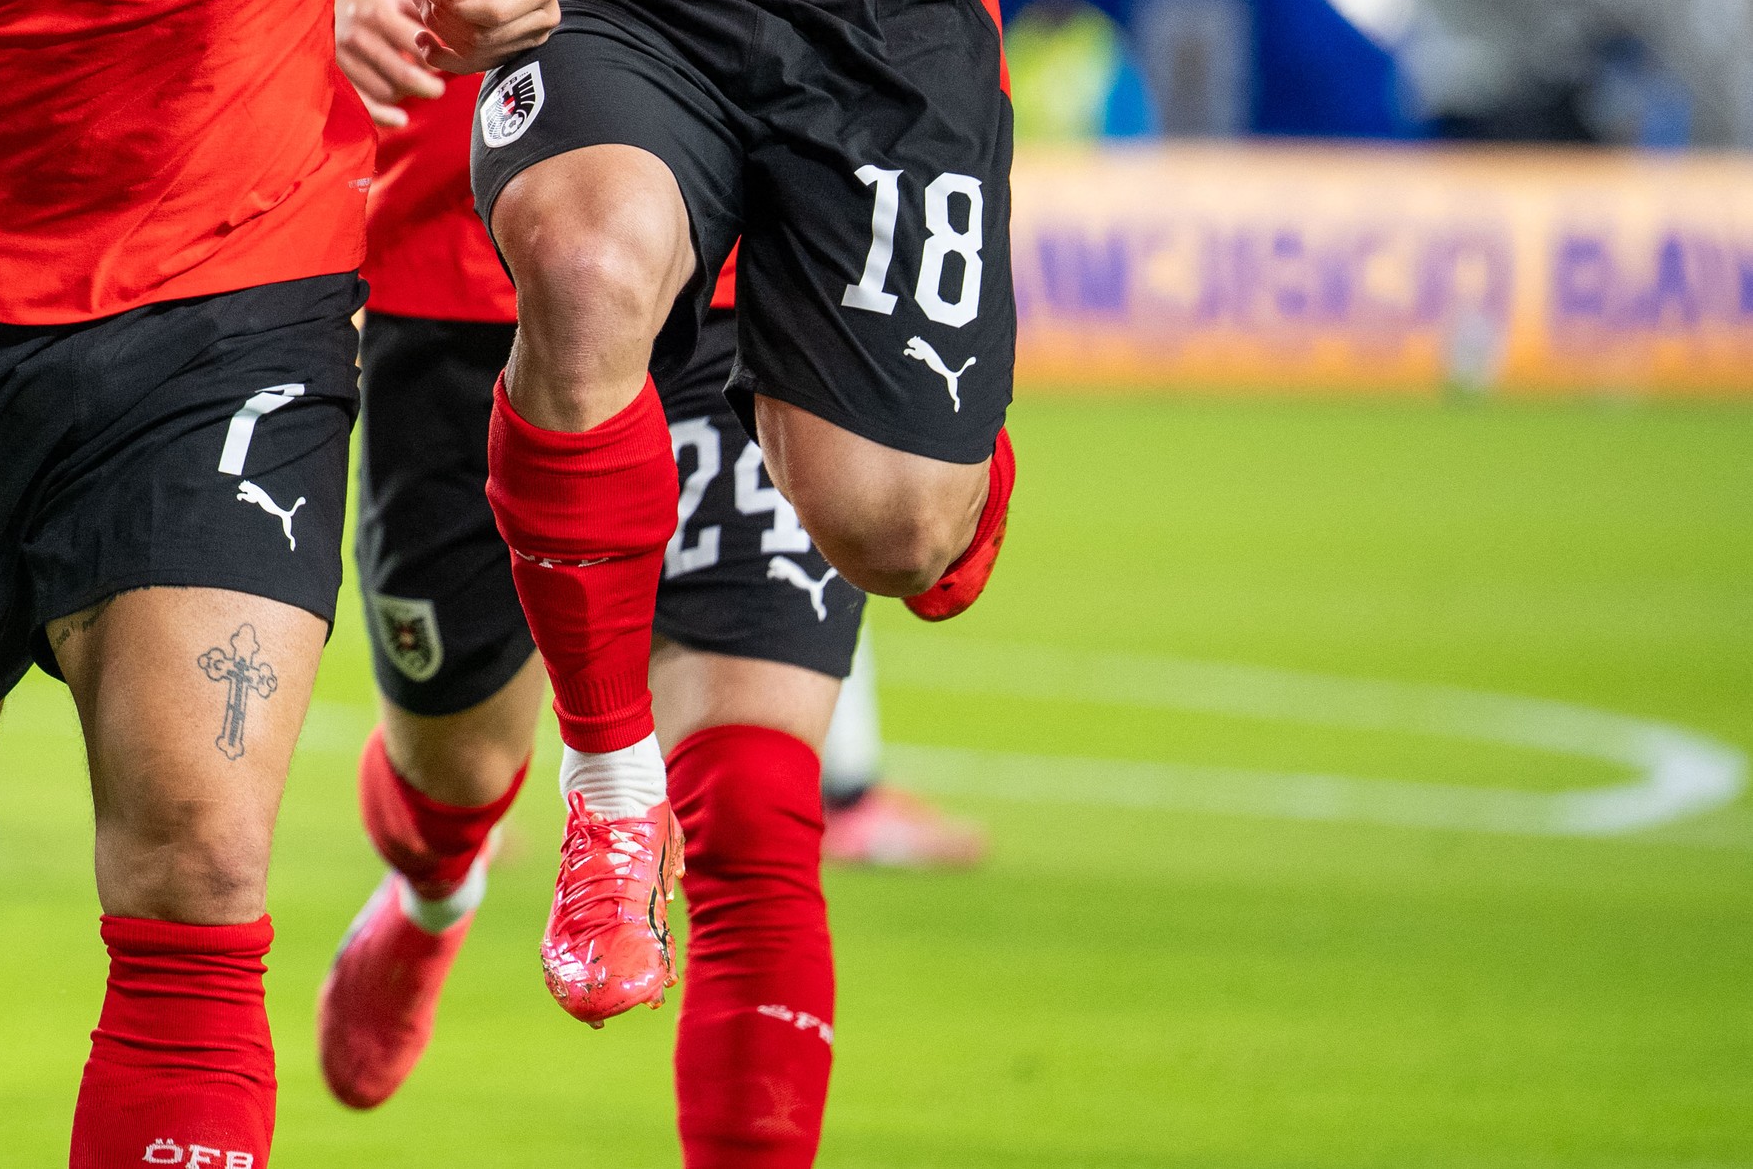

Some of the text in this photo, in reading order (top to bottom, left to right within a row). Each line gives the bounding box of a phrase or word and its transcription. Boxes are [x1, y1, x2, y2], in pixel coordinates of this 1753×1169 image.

[841, 164, 984, 329] 18
[218, 383, 306, 476] 7
[142, 1137, 254, 1169] ÖFB
